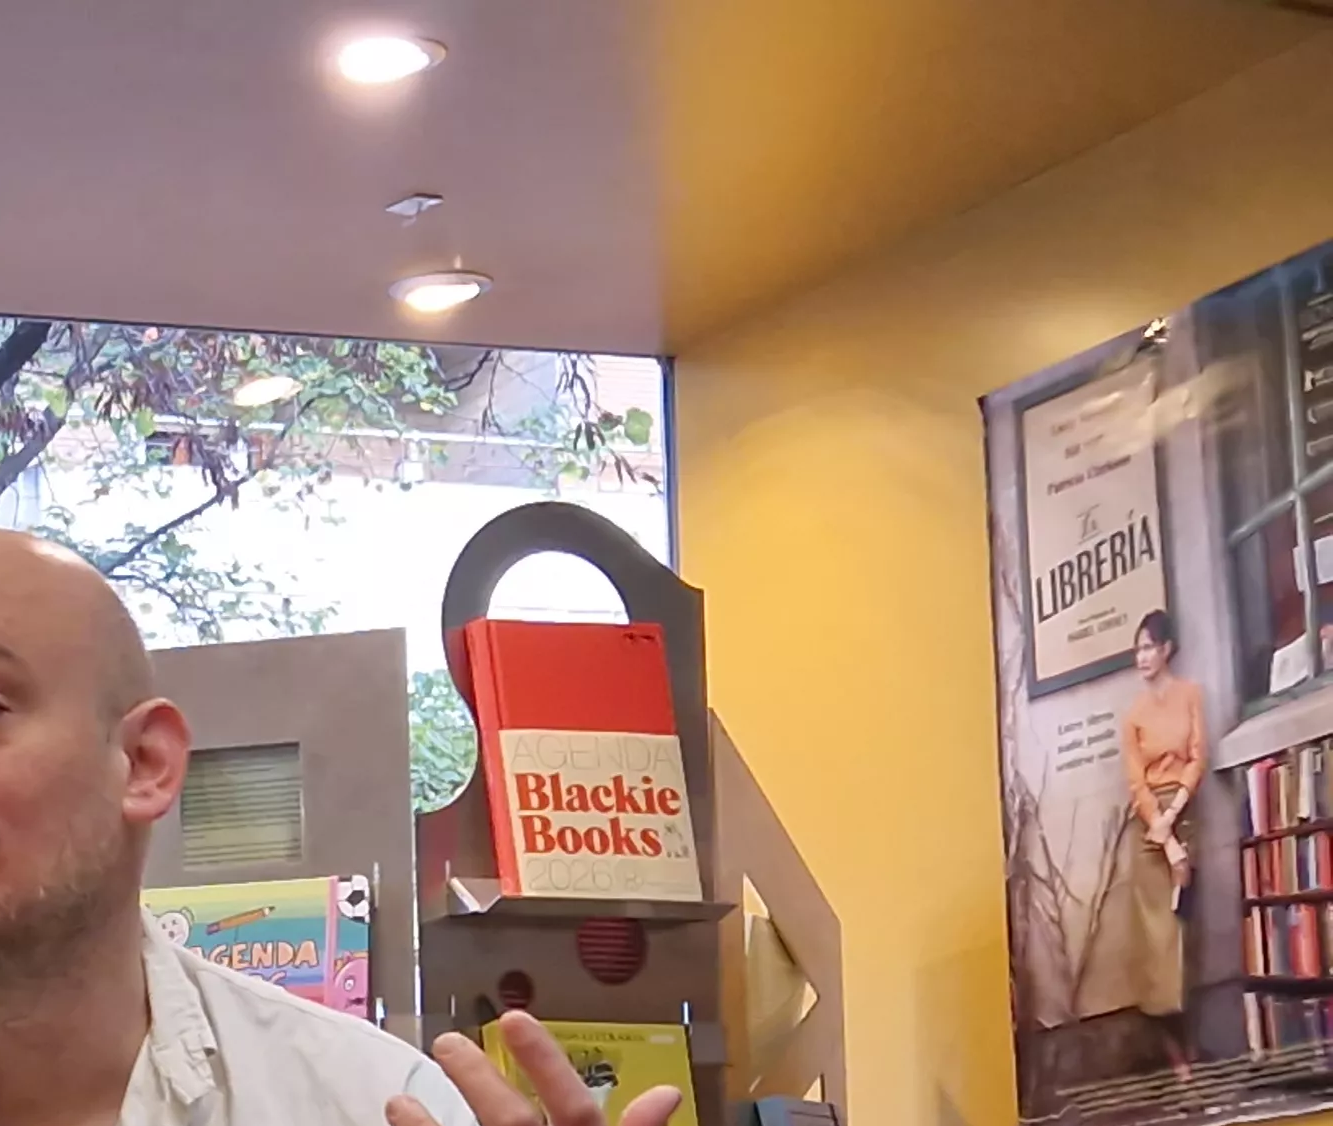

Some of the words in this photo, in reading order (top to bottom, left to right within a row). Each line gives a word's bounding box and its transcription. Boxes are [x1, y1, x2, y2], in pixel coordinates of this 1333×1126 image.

[1036, 508, 1156, 624] LIBRERÍA
[511, 735, 676, 772] AGENDA
[514, 772, 682, 816] Blackie
[518, 815, 663, 857] Books
[525, 859, 613, 892] 2026
